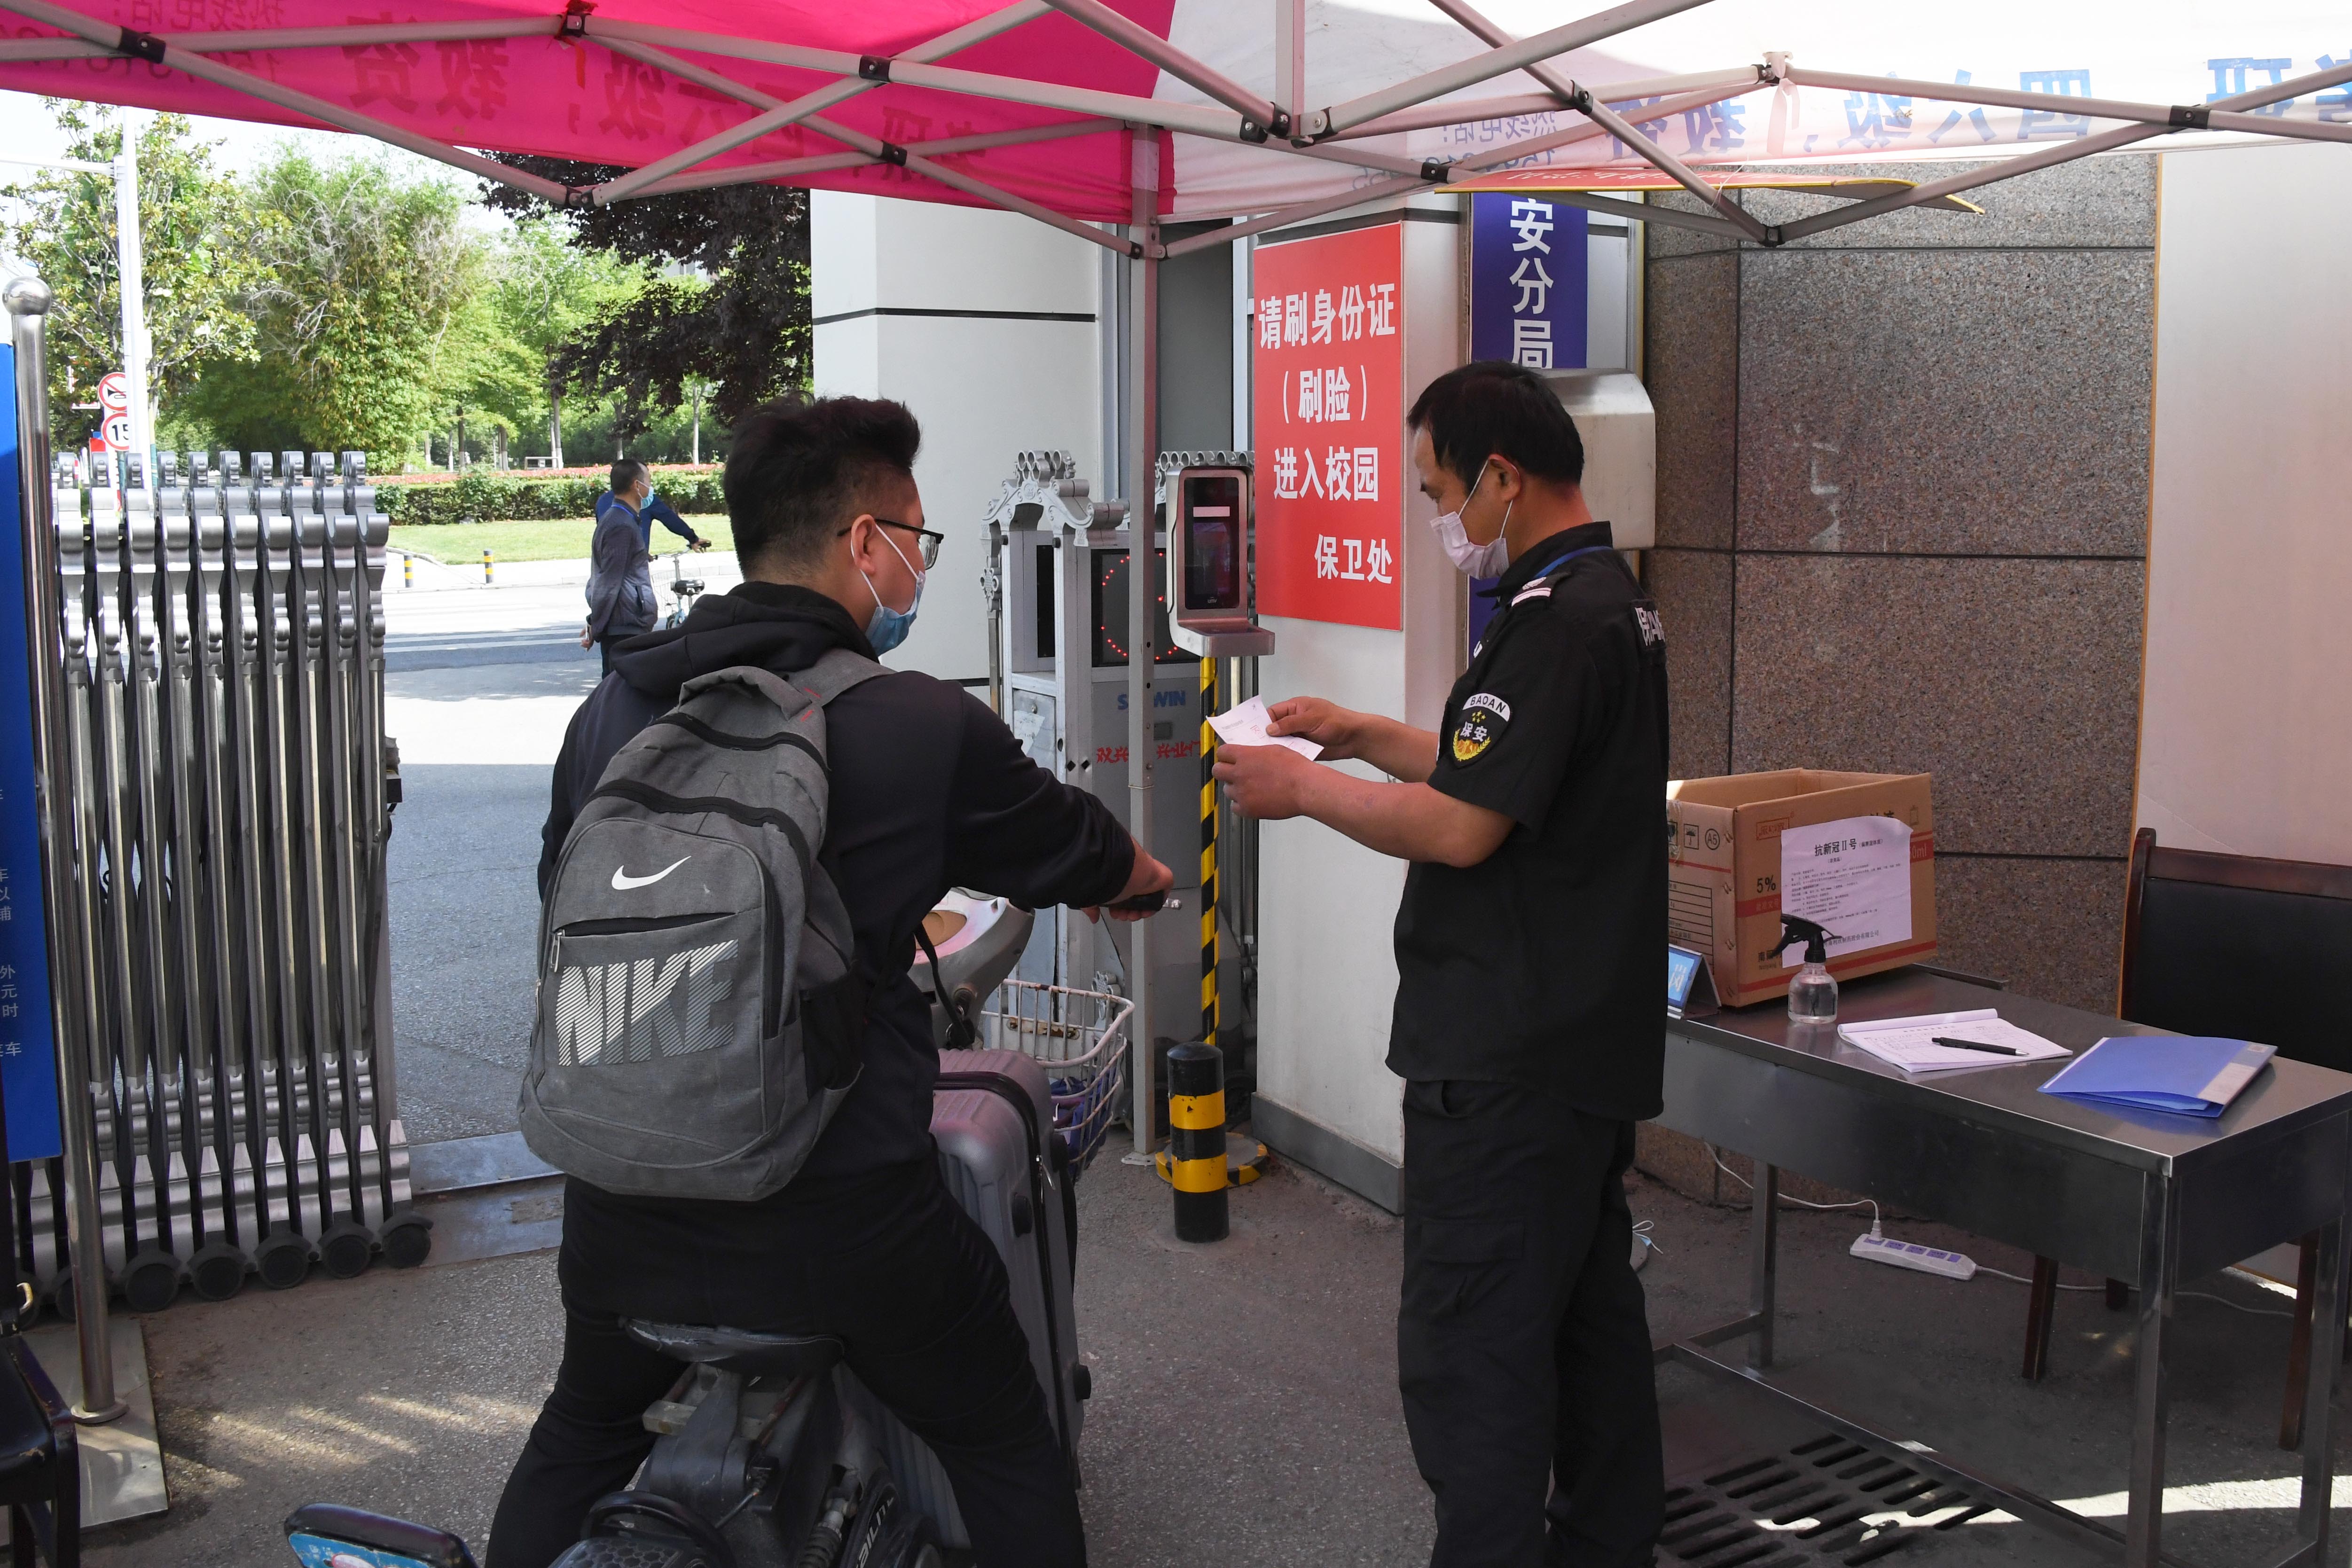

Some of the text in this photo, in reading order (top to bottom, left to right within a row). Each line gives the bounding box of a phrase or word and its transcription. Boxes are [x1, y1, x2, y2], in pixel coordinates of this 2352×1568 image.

[1509, 198, 1554, 369] 安分局
[1258, 283, 1396, 350] 请刷身份证
[1274, 446, 1379, 502] 进入校园
[1314, 533, 1393, 584] 保卫处
[1470, 695, 1506, 713] BAOAN
[1460, 721, 1488, 742] 保安
[1707, 833, 1717, 845] A5
[1757, 875, 1776, 894] 5%
[1, 984, 17, 999] 元
[2, 1003, 19, 1018] 时
[556, 939, 738, 1066] NIKE
[0, 1042, 22, 1057] 车
